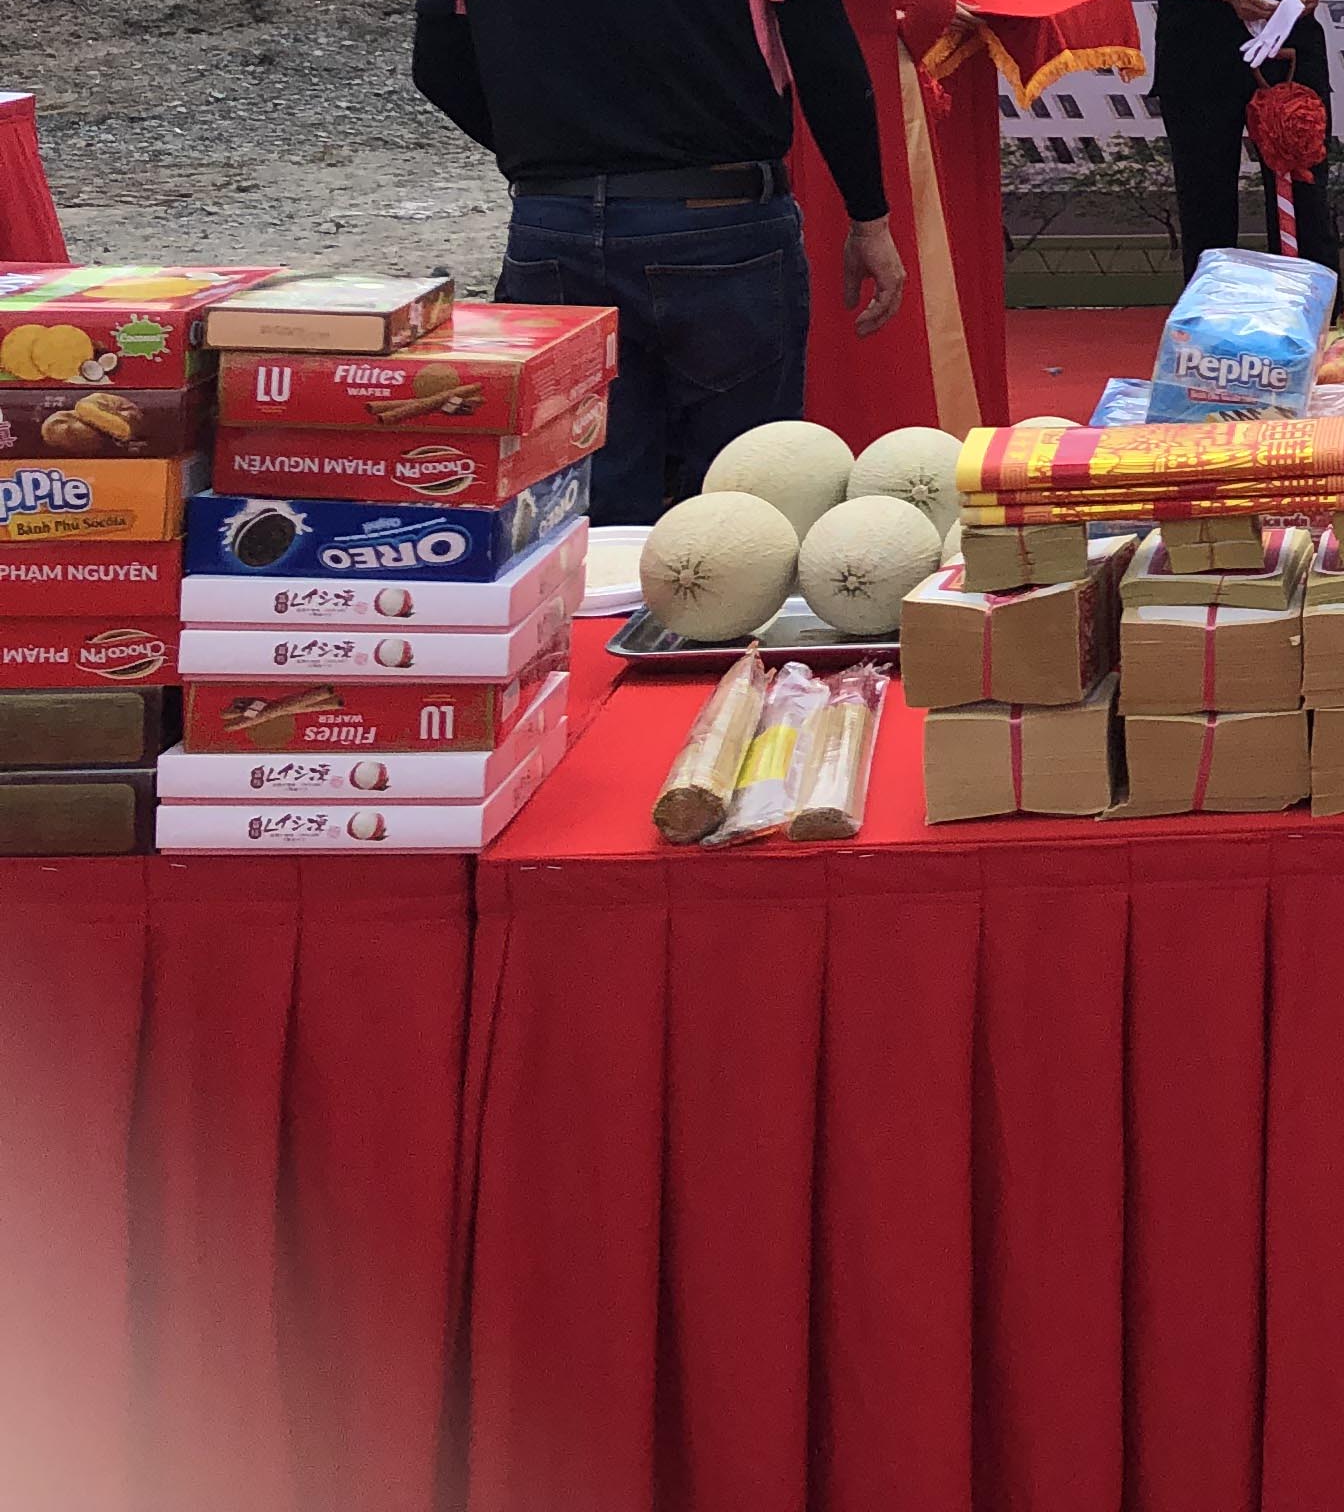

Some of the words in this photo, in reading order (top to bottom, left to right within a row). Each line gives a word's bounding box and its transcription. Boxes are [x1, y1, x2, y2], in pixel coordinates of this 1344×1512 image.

[334, 364, 406, 386] Flûtes
[1176, 348, 1289, 390] PepPie
[256, 366, 291, 402] LU
[347, 387, 391, 397] WAFER
[234, 454, 316, 473] NGUYÊN
[323, 455, 387, 476] PHẠM
[321, 531, 467, 569] OREO
[67, 562, 158, 581] NGUYÊN
[3, 644, 69, 663] PHẠM
[318, 714, 363, 724] WAFER
[420, 705, 455, 739] LU
[303, 725, 377, 745] Flûtes
